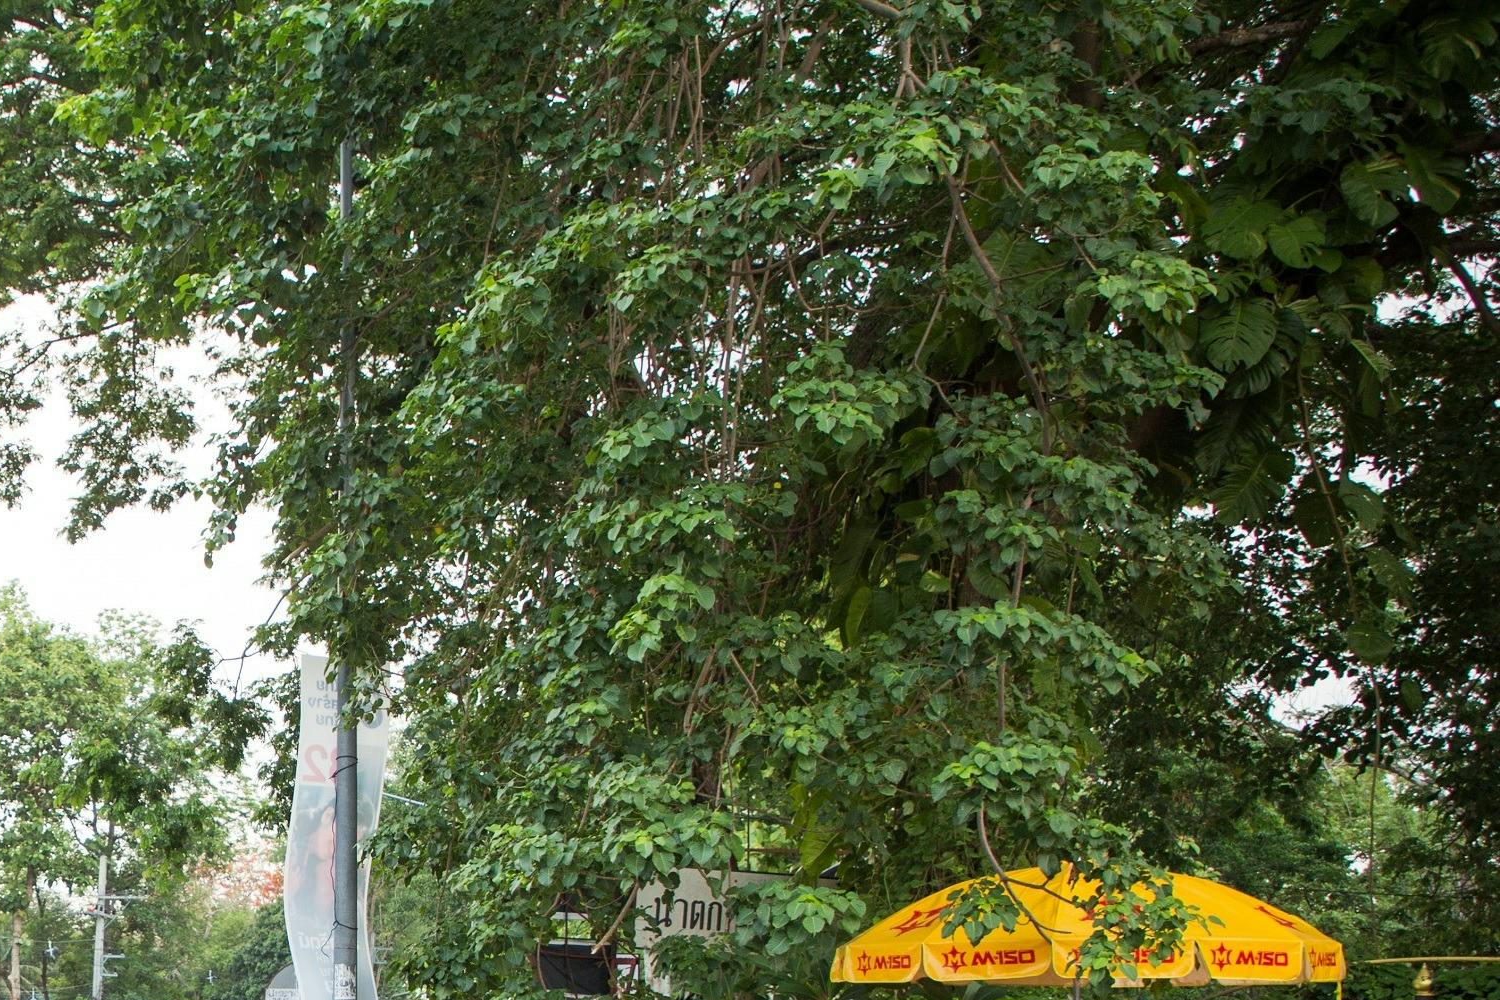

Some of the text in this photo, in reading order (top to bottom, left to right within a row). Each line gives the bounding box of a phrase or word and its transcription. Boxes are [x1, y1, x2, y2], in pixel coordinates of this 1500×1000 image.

[874, 955, 911, 969] M-150
[971, 949, 1036, 966] M-150
[1235, 951, 1288, 967] M-150
